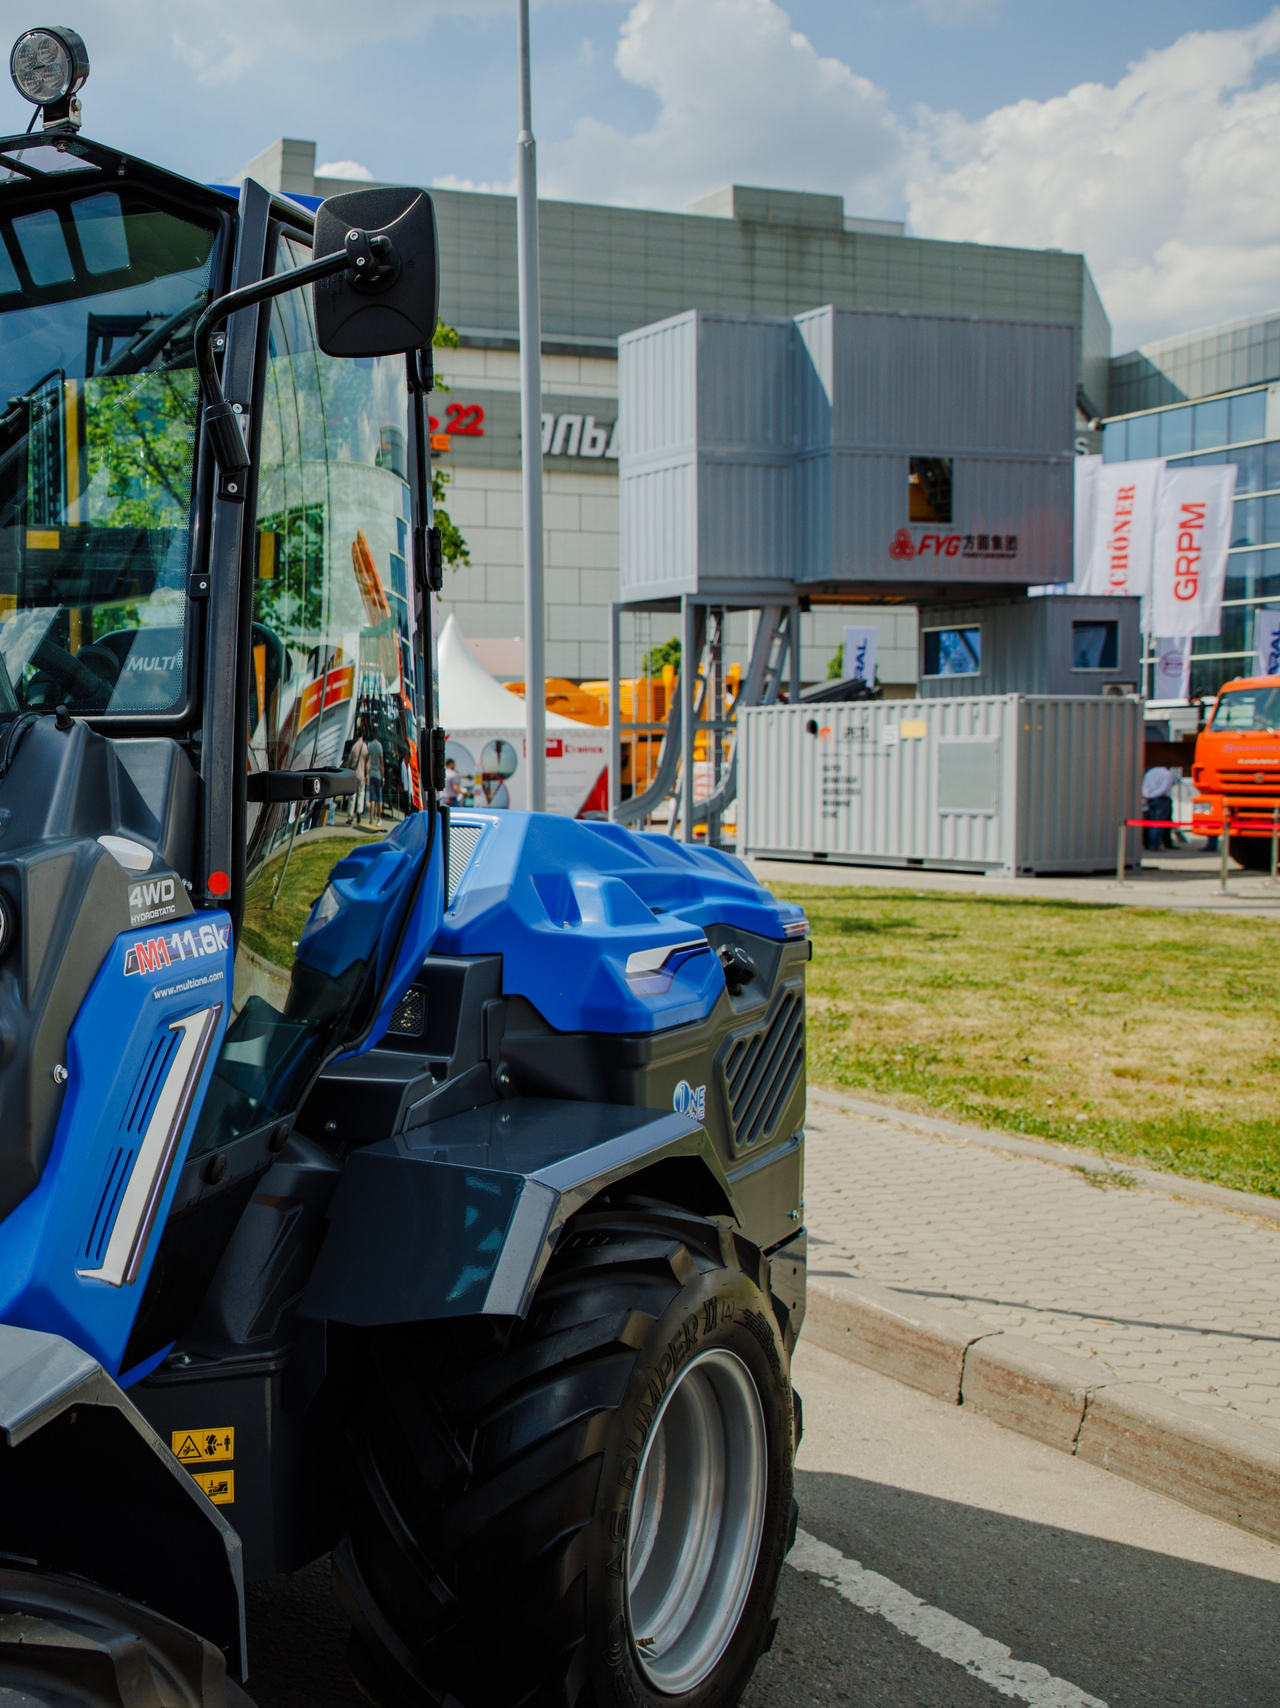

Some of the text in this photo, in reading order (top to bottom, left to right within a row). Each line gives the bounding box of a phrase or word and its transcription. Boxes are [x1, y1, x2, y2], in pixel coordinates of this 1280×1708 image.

[446, 403, 485, 436] 22
[917, 534, 962, 556] FYG
[1104, 484, 1136, 597] CHÖNER
[1174, 502, 1206, 601] GRPM
[129, 879, 175, 908] 4WD
[130, 905, 176, 924] HYDROSTATIC
[134, 936, 172, 976] M1
[153, 971, 224, 999] www.multione.com
